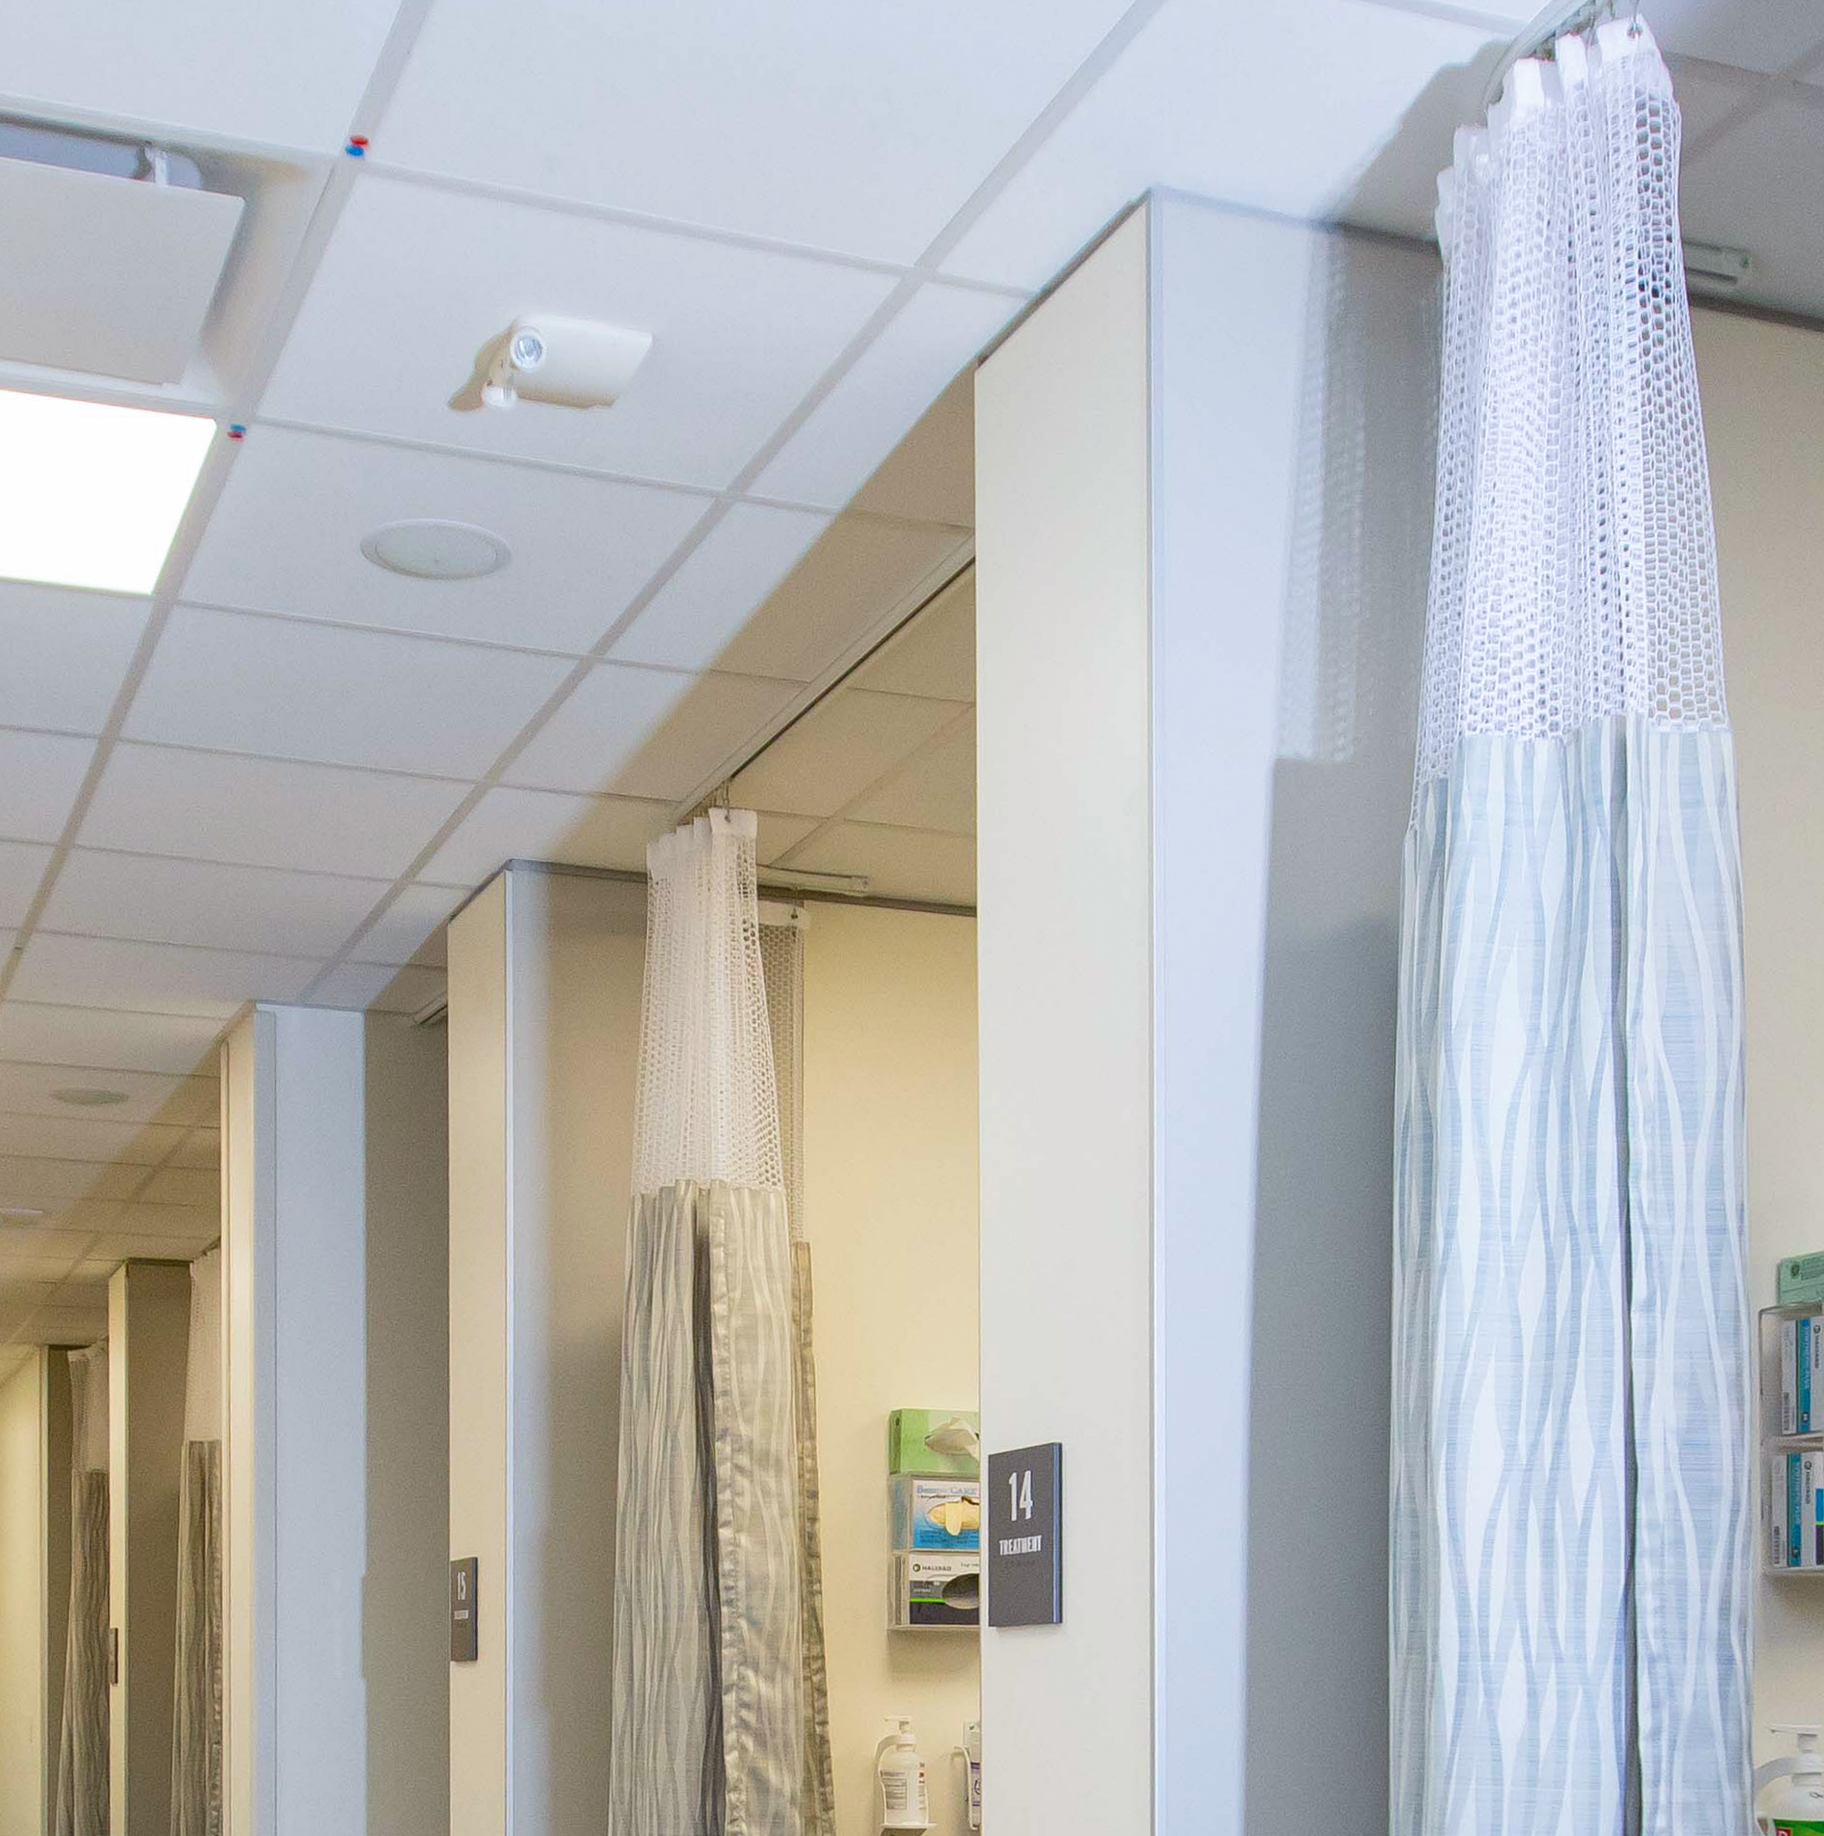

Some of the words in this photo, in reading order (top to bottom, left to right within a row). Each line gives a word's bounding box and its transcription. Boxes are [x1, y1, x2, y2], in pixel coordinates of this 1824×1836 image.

[1008, 1470, 1034, 1522] 14
[999, 1535, 1042, 1556] TREATMENT
[457, 1571, 467, 1601] 15
